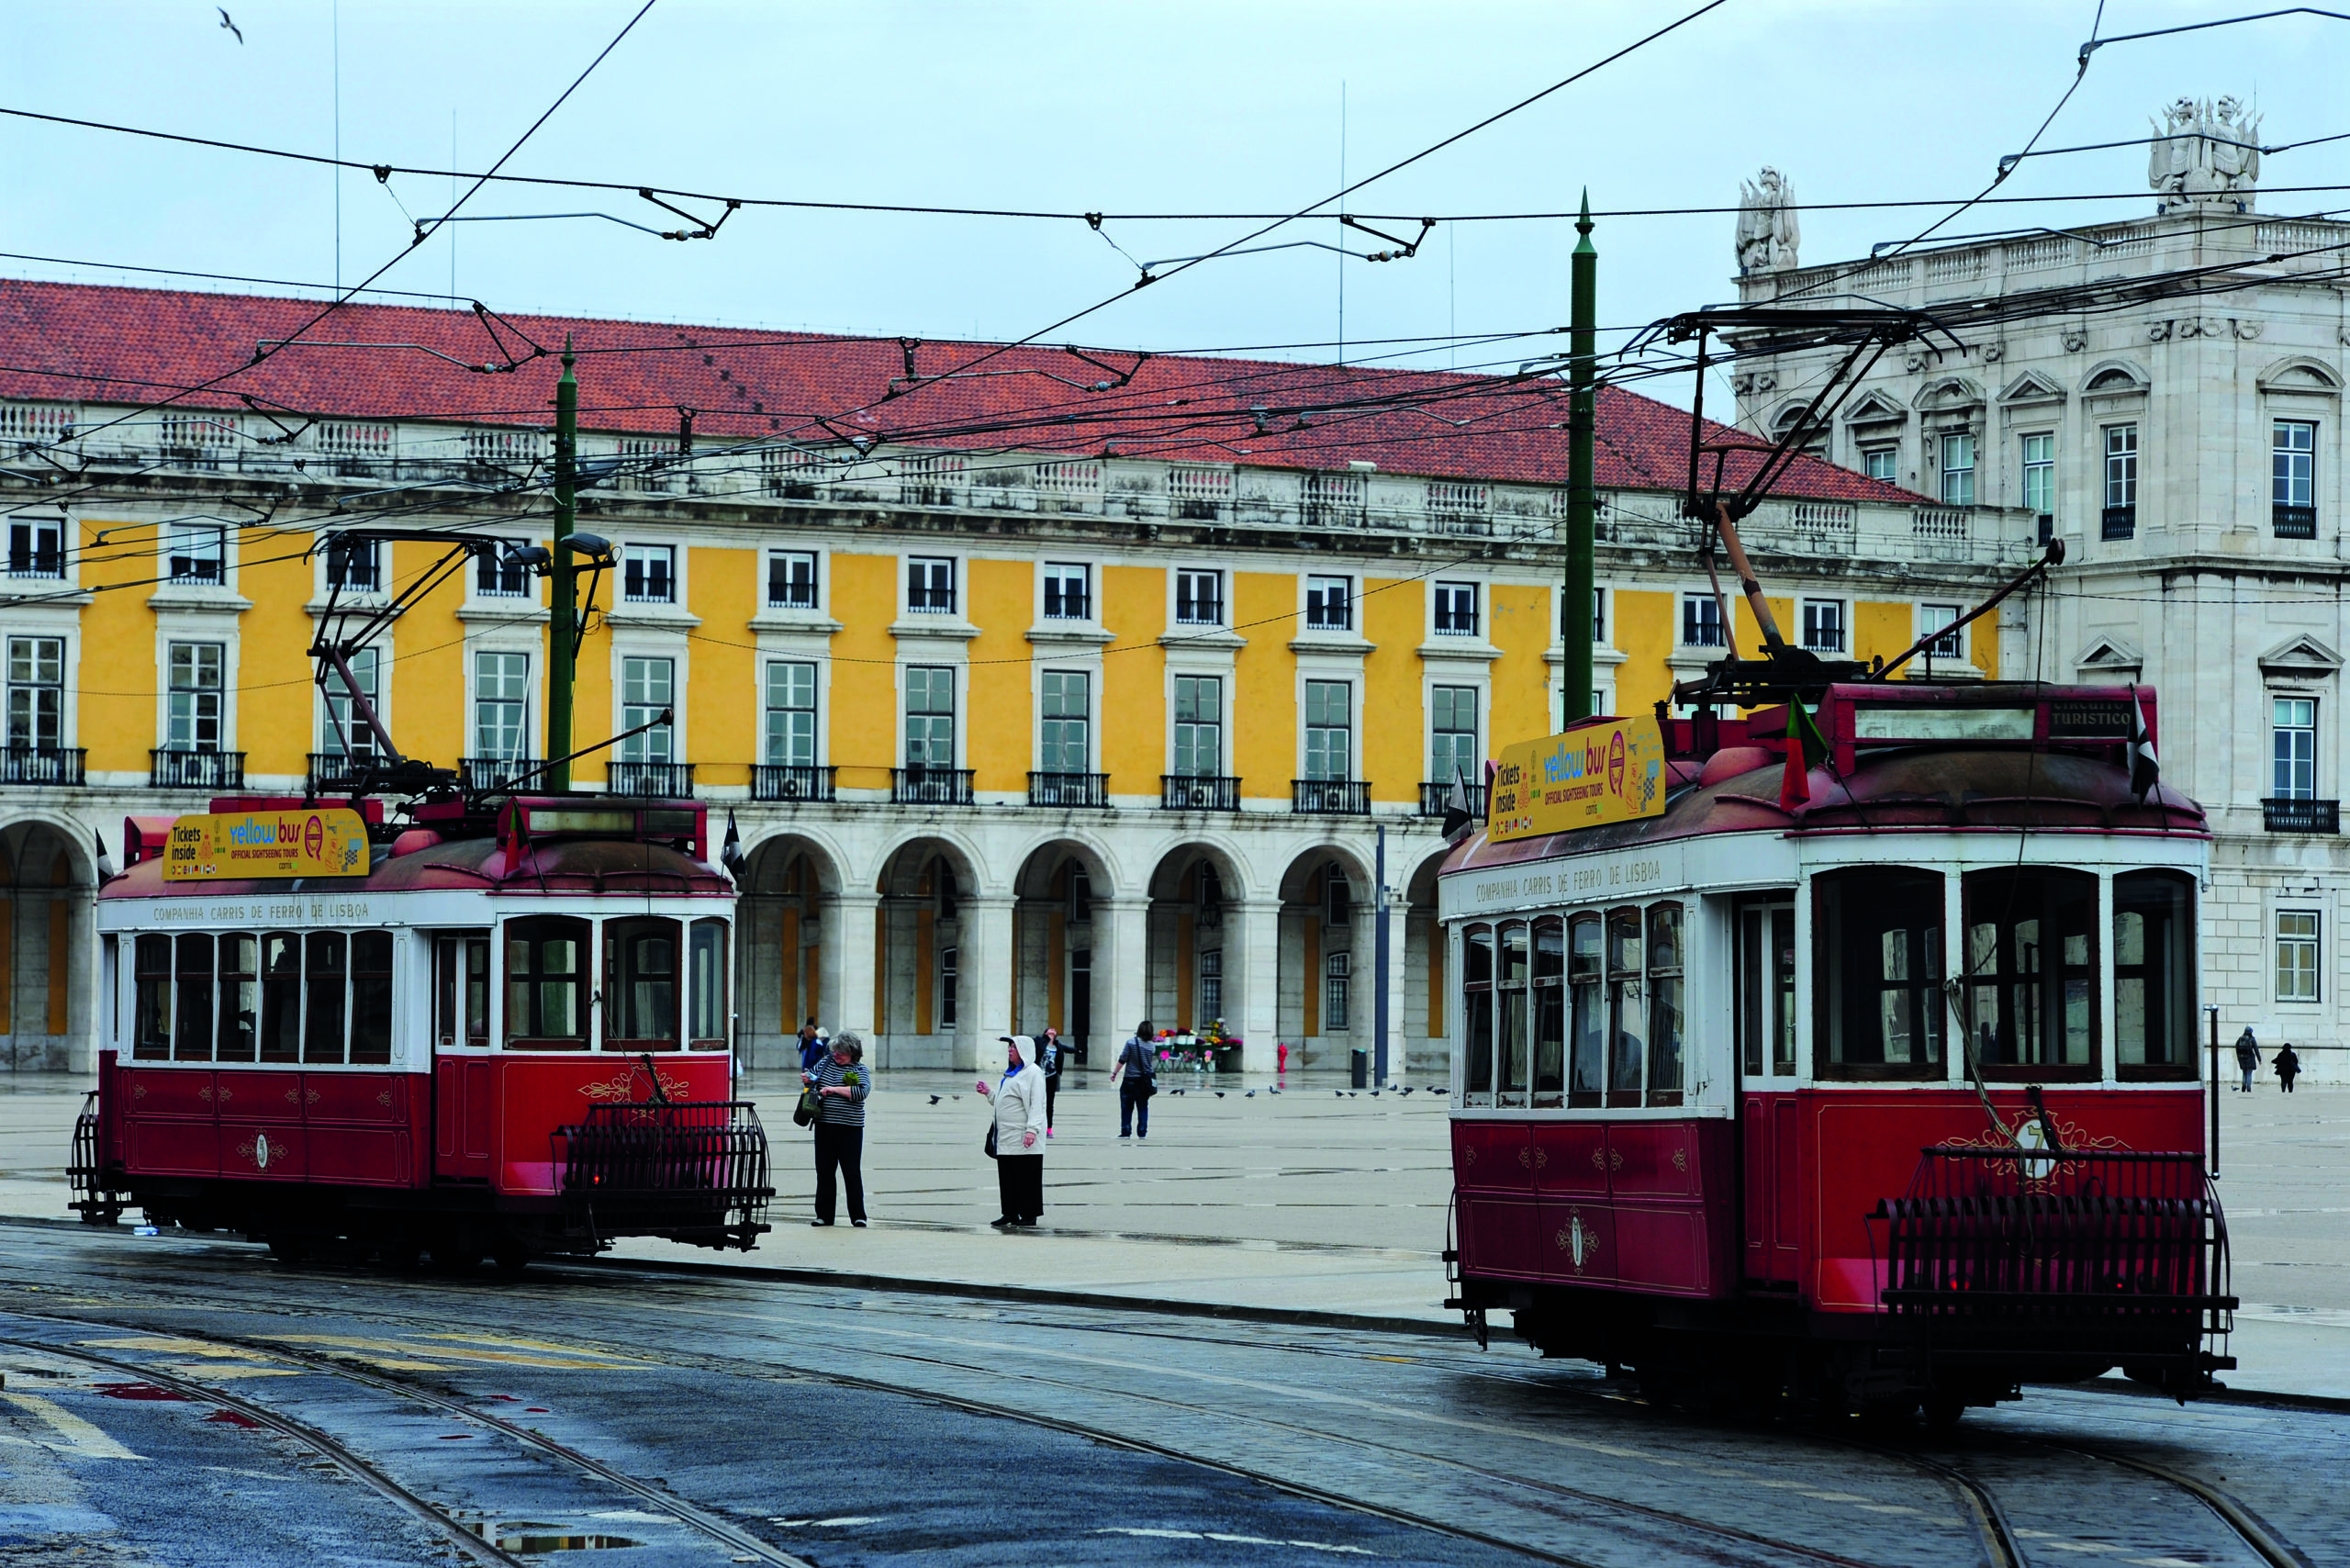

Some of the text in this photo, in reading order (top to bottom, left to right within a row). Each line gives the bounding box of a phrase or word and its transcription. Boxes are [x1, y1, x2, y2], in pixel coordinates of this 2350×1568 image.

[2051, 710, 2131, 725] TURÍSTICO
[1544, 736, 1606, 785] yellow bus
[1497, 762, 1520, 788] Tickets
[1496, 789, 1516, 814] inside
[1545, 782, 1604, 806] OFFICIAL SIGHTSEEING TOURS
[173, 825, 201, 843] Tickets
[229, 815, 301, 846] yellow bus
[172, 844, 196, 861] inside
[231, 847, 298, 859] OFFICIAL SIGHTSEEING TOURS
[1476, 860, 1661, 903] COMPANHIA CARRIS DE FERRO DE LISBOA
[153, 903, 369, 921] COMPANHIA CARRIS DE FERRO DE LISBOA
[2027, 1124, 2044, 1173] 7
